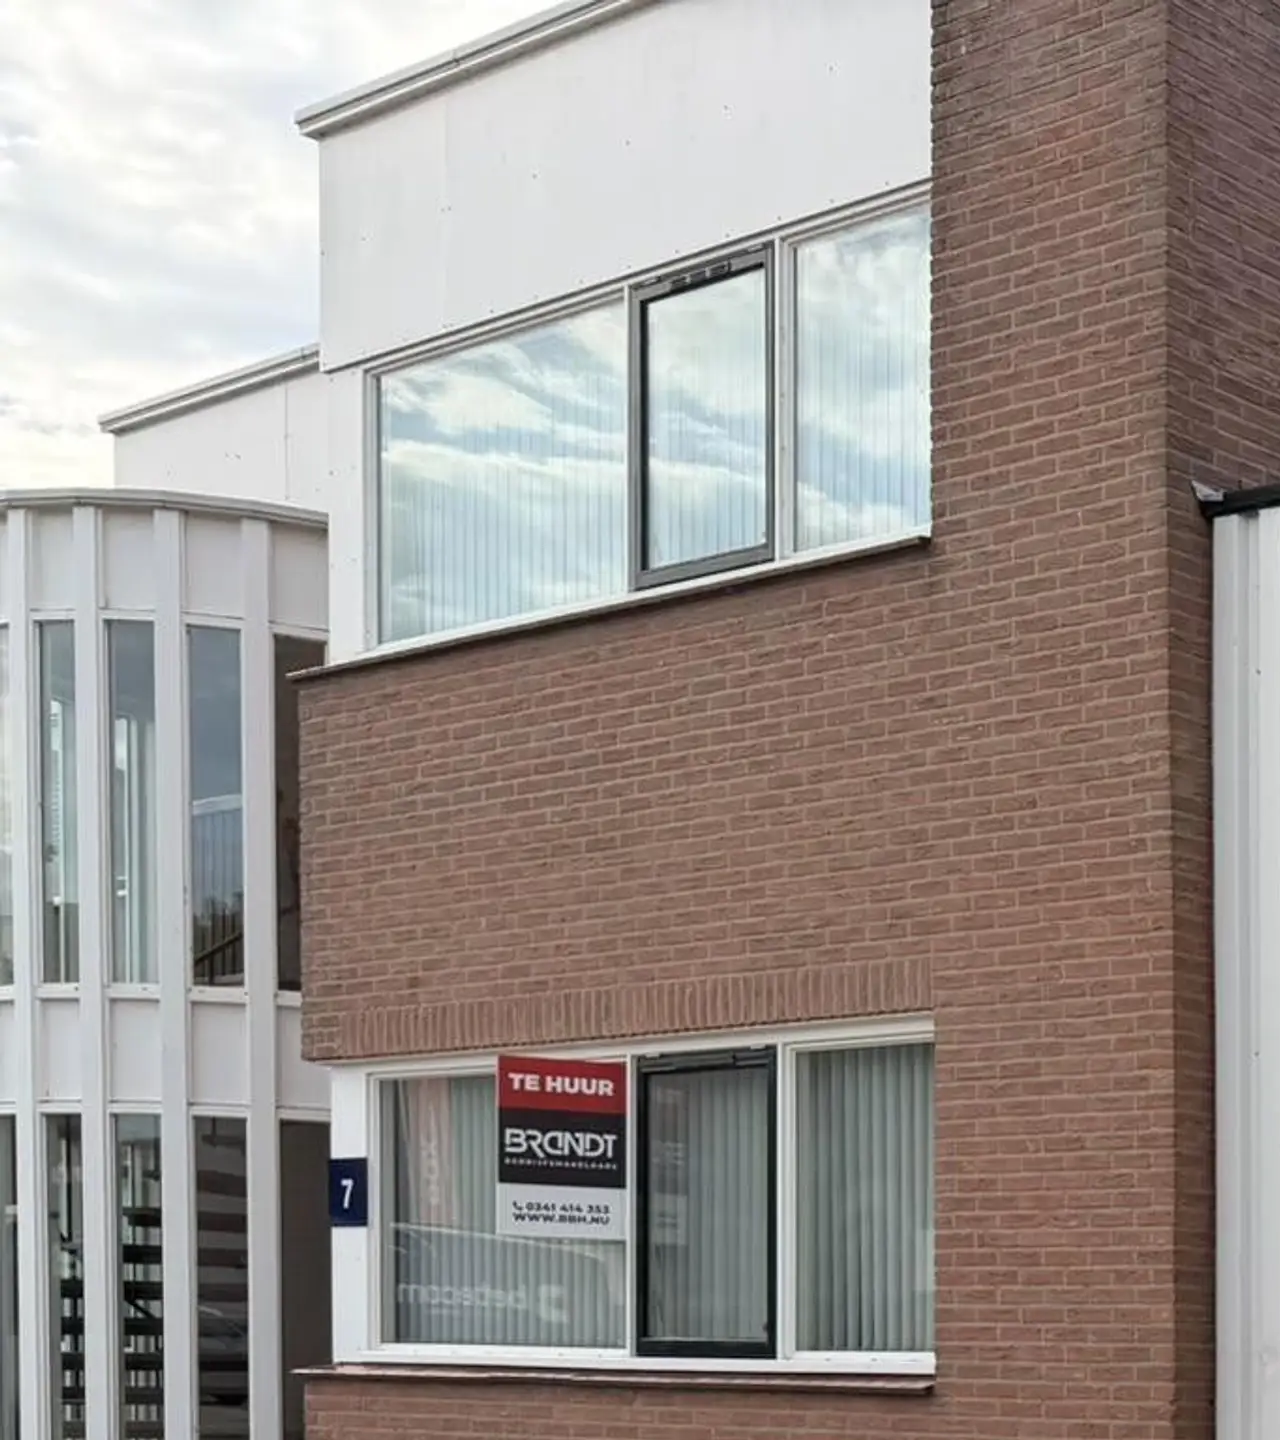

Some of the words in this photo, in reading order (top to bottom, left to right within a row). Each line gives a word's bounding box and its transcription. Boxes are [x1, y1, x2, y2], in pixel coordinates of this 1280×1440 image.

[508, 1073, 540, 1091] TE
[546, 1075, 614, 1097] HUUR
[505, 1127, 618, 1158] BRANDT
[341, 1178, 354, 1210] 7
